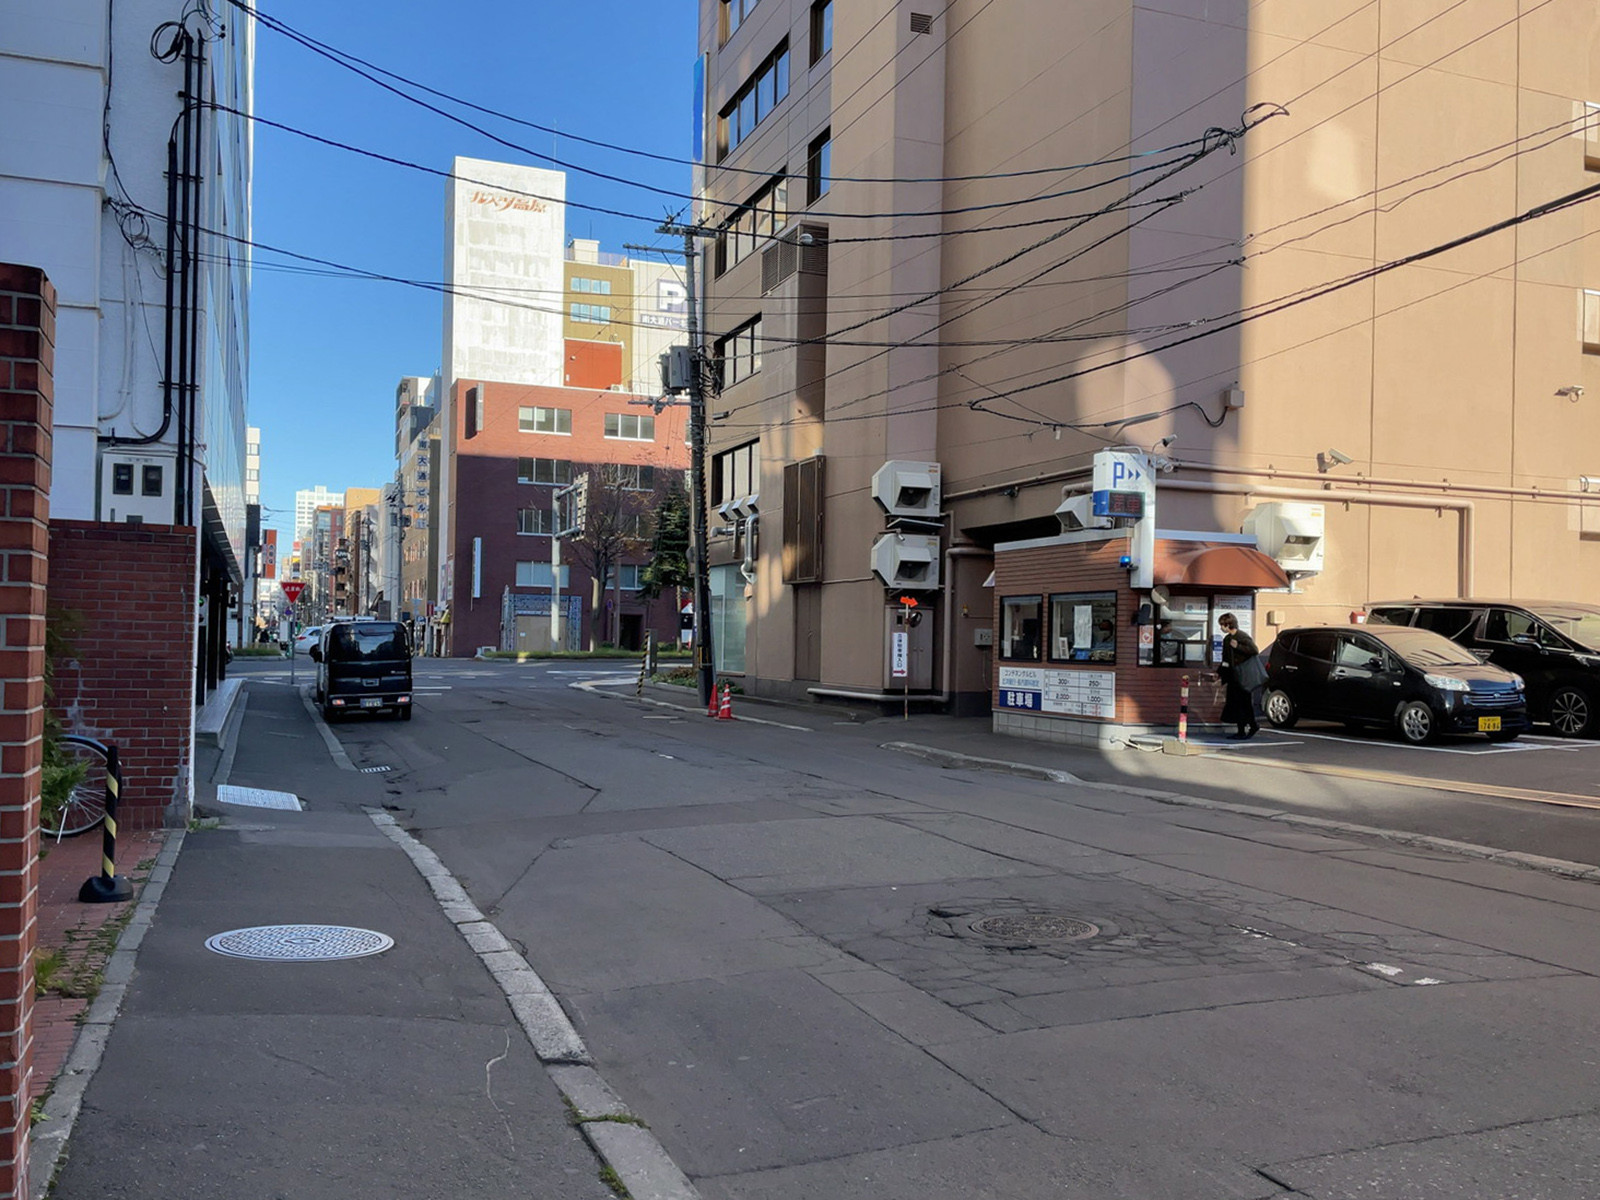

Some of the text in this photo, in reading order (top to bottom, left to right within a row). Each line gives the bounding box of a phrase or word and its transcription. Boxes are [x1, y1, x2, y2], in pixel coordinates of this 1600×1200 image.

[659, 281, 689, 311] P
[416, 438, 429, 513] 南大通ビル
[1113, 461, 1125, 489] P
[1007, 691, 1033, 708] 駐車場
